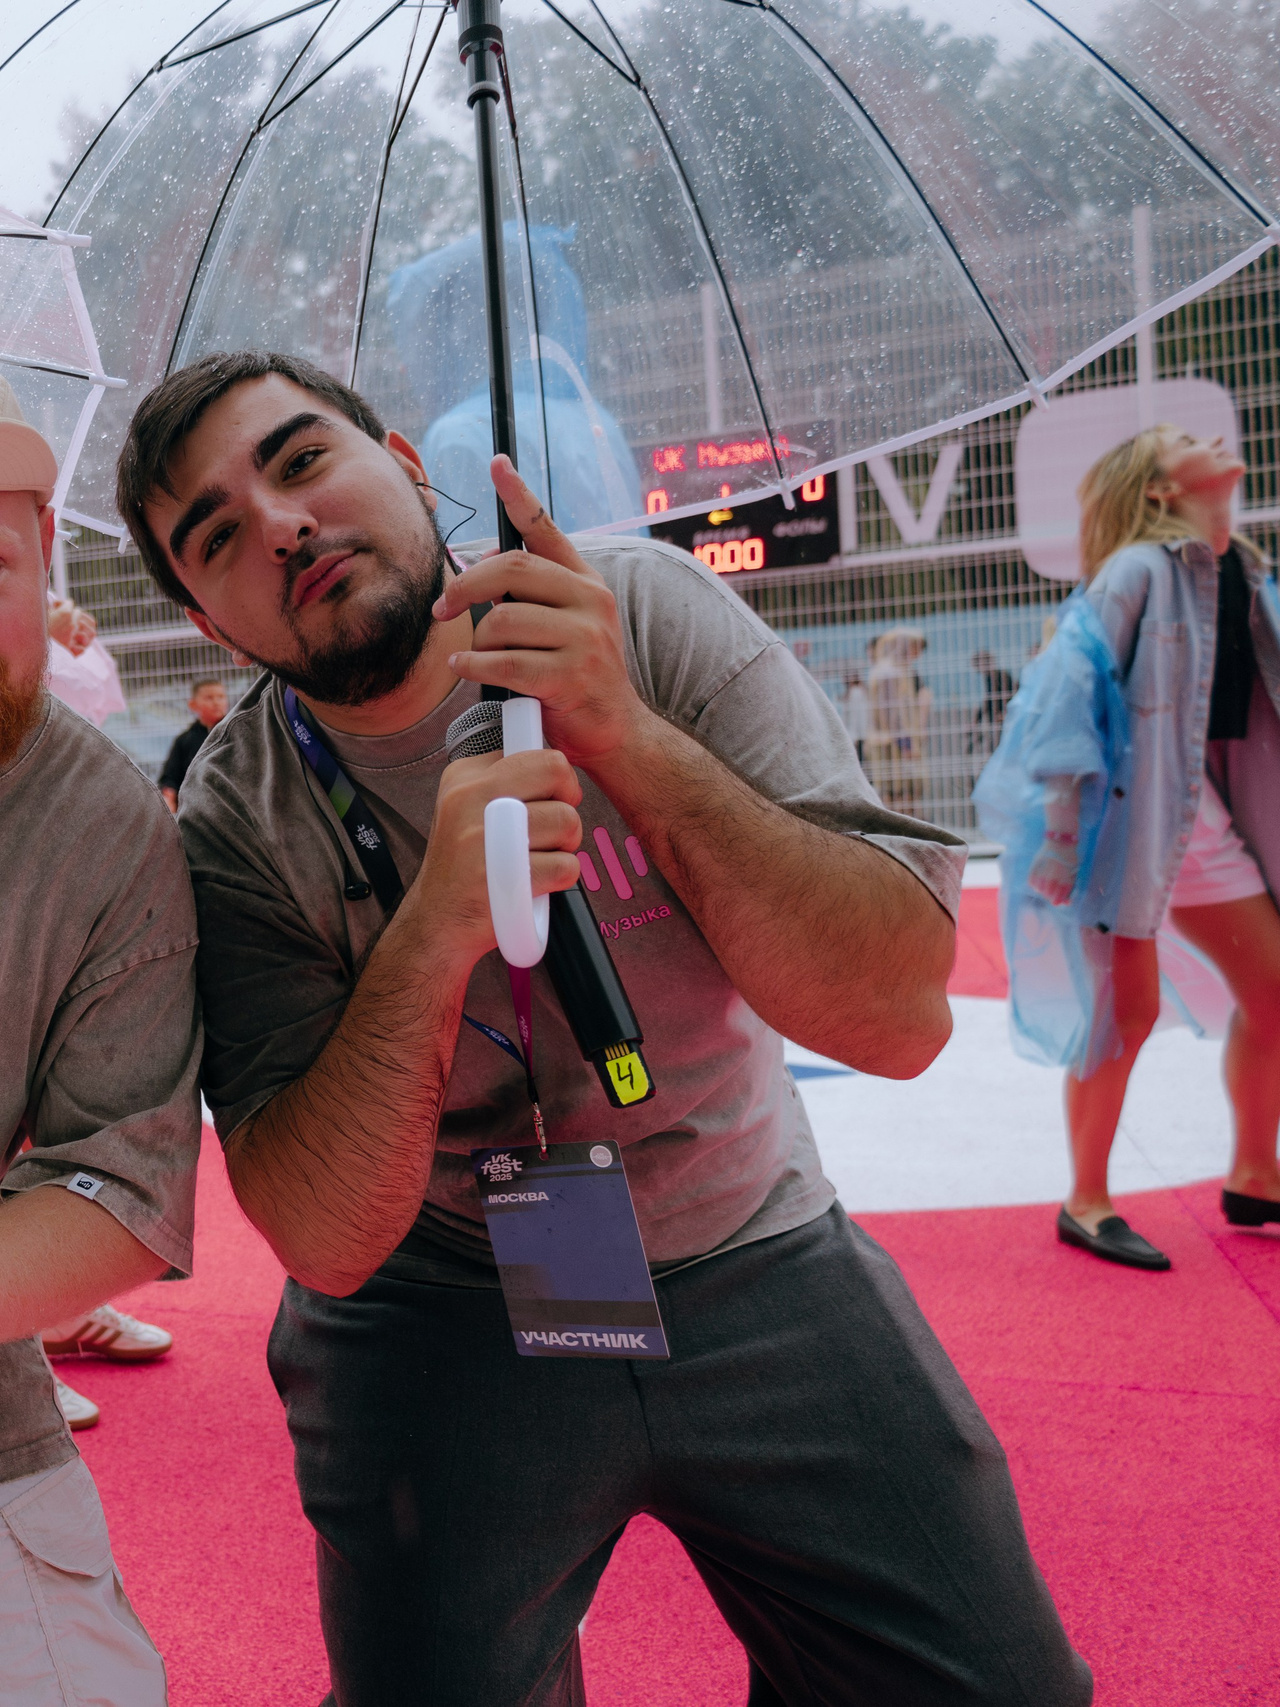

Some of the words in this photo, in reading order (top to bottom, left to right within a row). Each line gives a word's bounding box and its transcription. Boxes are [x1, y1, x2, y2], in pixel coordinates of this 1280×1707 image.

[616, 1062, 635, 1091] 4
[491, 1153, 511, 1164] VK
[481, 1158, 523, 1175] fest
[489, 1172, 513, 1182] 2025
[488, 1191, 550, 1204] МОСКВА
[521, 1330, 648, 1349] УЧАСТНИК
